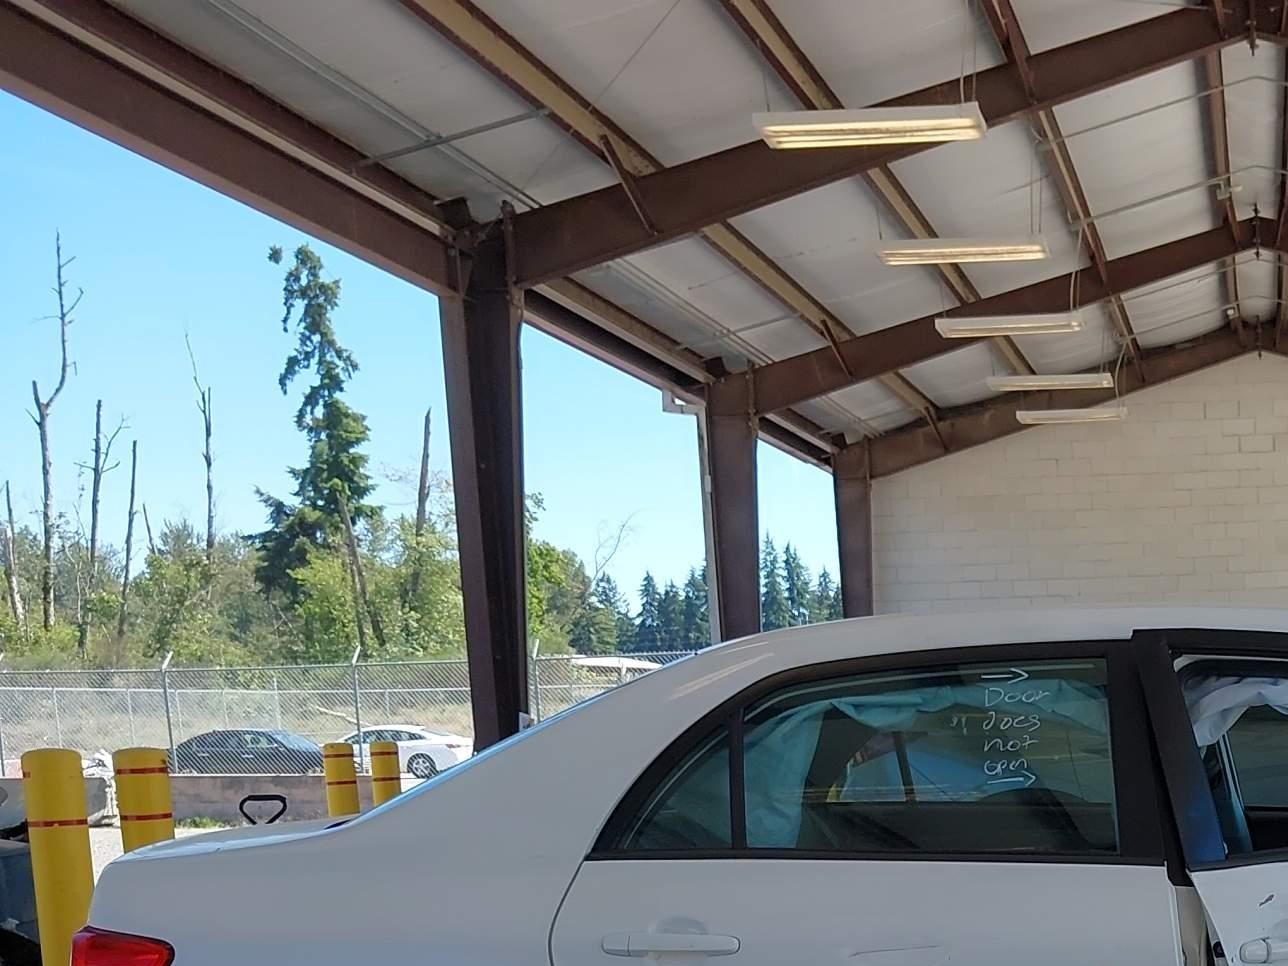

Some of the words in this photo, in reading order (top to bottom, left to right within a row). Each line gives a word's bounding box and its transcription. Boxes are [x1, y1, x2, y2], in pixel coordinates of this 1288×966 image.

[984, 687, 1050, 707] Door
[982, 711, 1041, 732] does
[983, 734, 1039, 752] not
